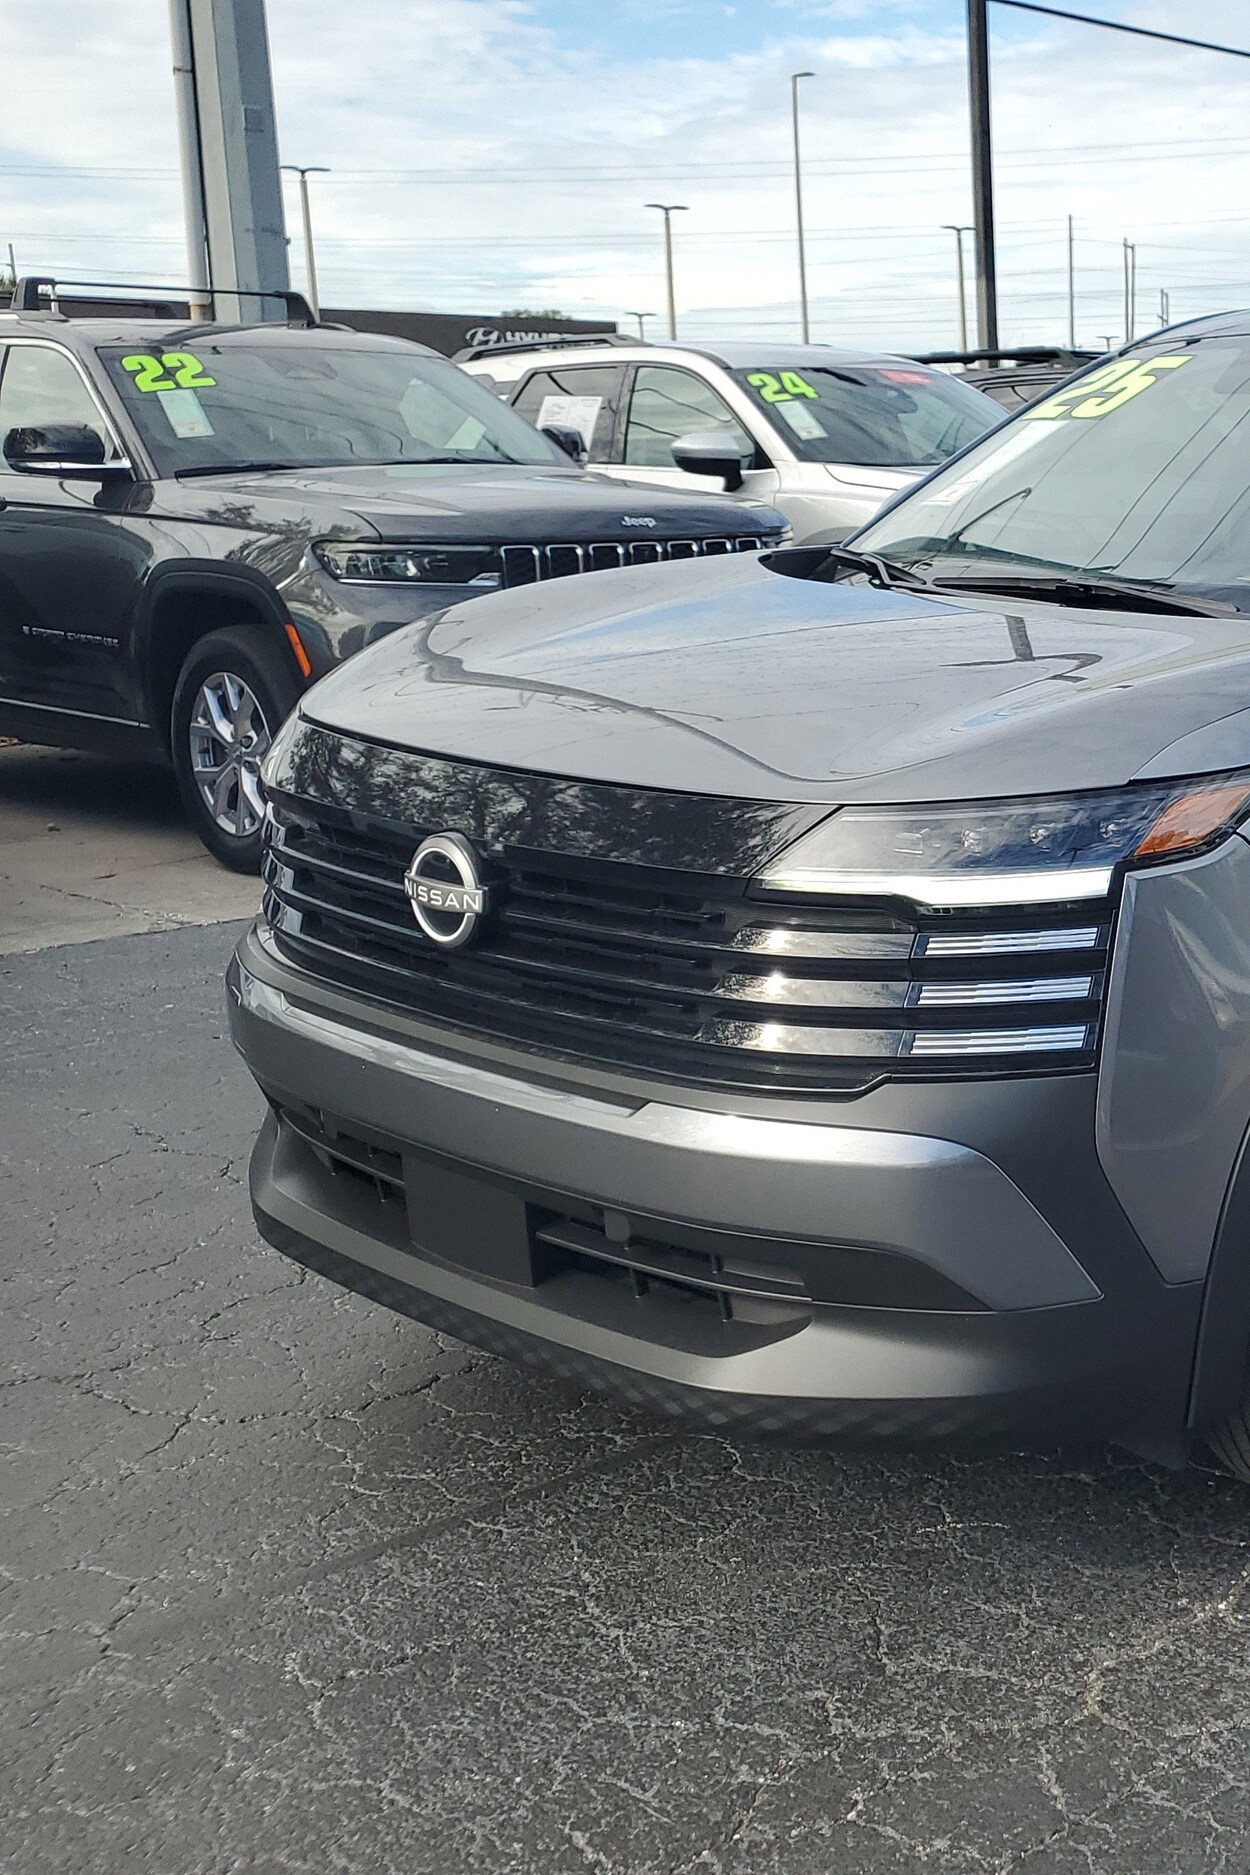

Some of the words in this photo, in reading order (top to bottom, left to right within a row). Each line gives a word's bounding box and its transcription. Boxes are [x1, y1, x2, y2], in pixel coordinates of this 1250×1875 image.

[121, 352, 217, 393] 22
[747, 371, 820, 404] 24
[1022, 354, 1195, 420] 25
[620, 515, 658, 528] Jeep
[404, 877, 480, 911] NISSAN
